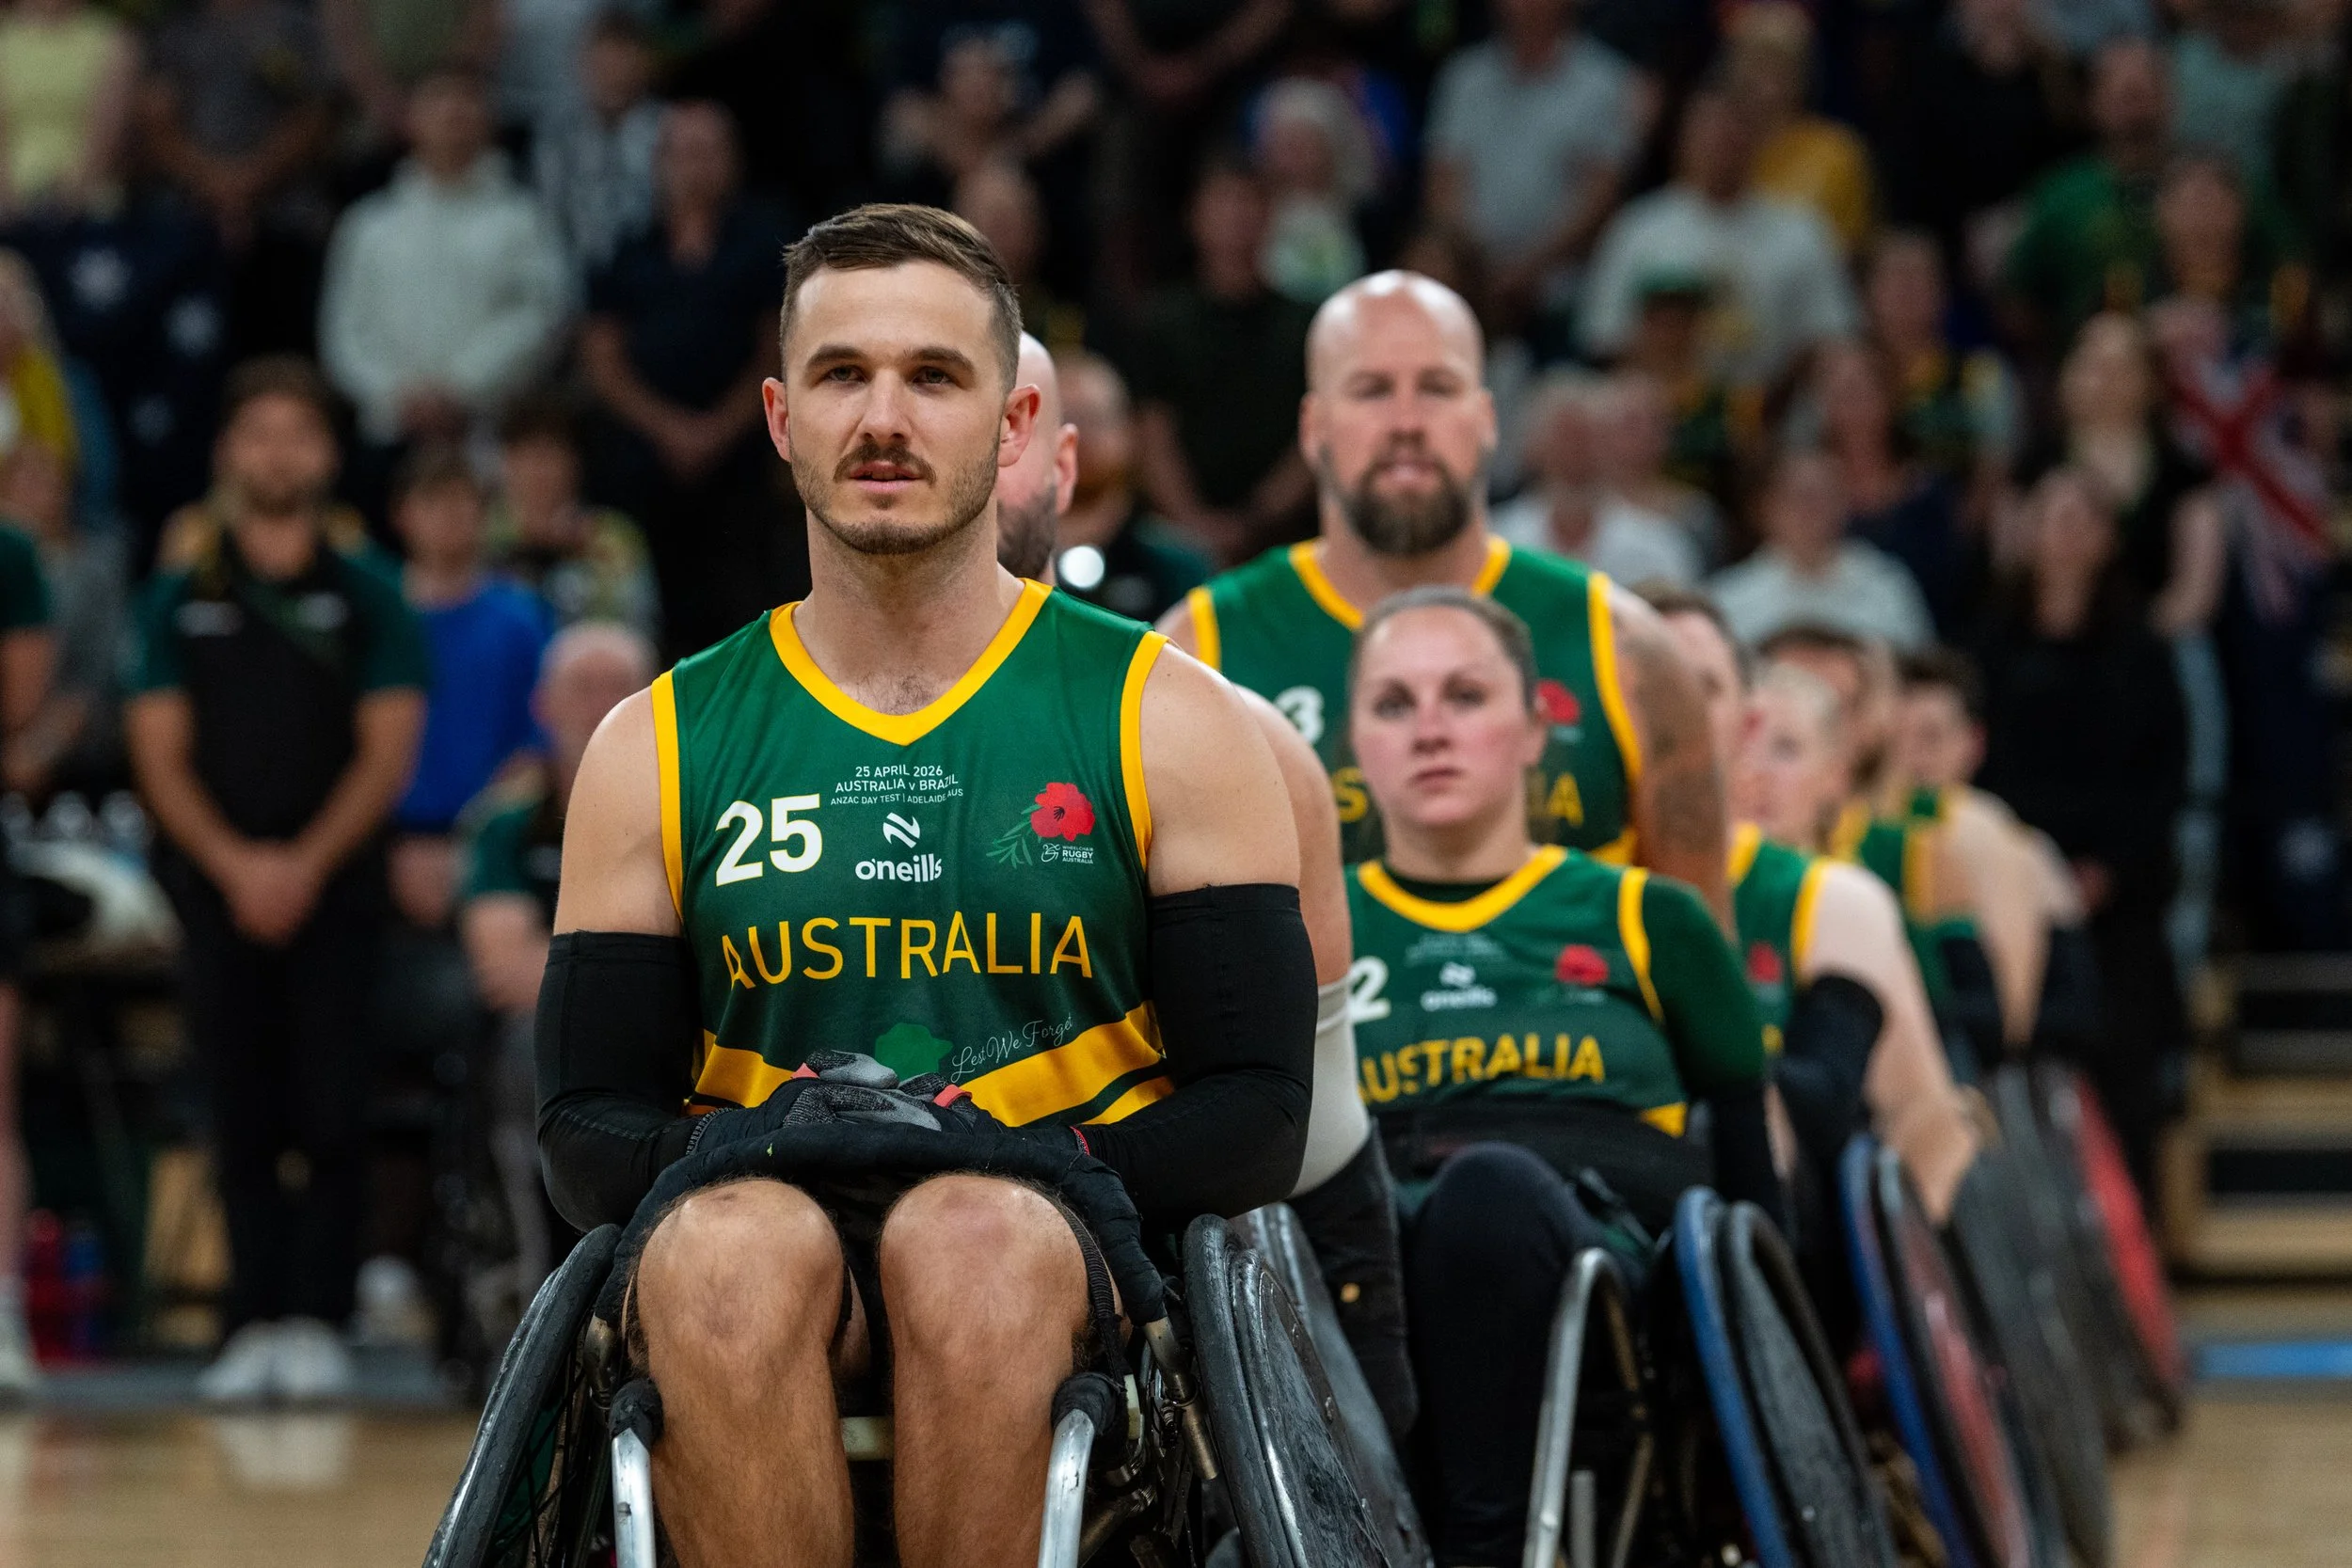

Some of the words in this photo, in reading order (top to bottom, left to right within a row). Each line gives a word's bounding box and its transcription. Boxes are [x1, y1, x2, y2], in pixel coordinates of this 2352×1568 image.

[855, 766, 870, 777] 25
[874, 764, 910, 778] APRIL
[913, 765, 944, 777] 2026
[834, 778, 906, 793] AUSTRALIA
[919, 773, 959, 791] BRAZIL
[830, 796, 860, 806] ANZAC
[861, 796, 879, 804] DAY
[880, 793, 901, 803] TEST
[907, 793, 947, 804] ADELAIDE
[947, 788, 964, 799] AUS
[715, 792, 823, 887] 25
[1061, 849, 1094, 859] RUGBY
[722, 911, 1093, 990] AUSTRALIA
[950, 1046, 987, 1083] Lest
[986, 1030, 1023, 1064] We
[1022, 1012, 1073, 1047] Forget
